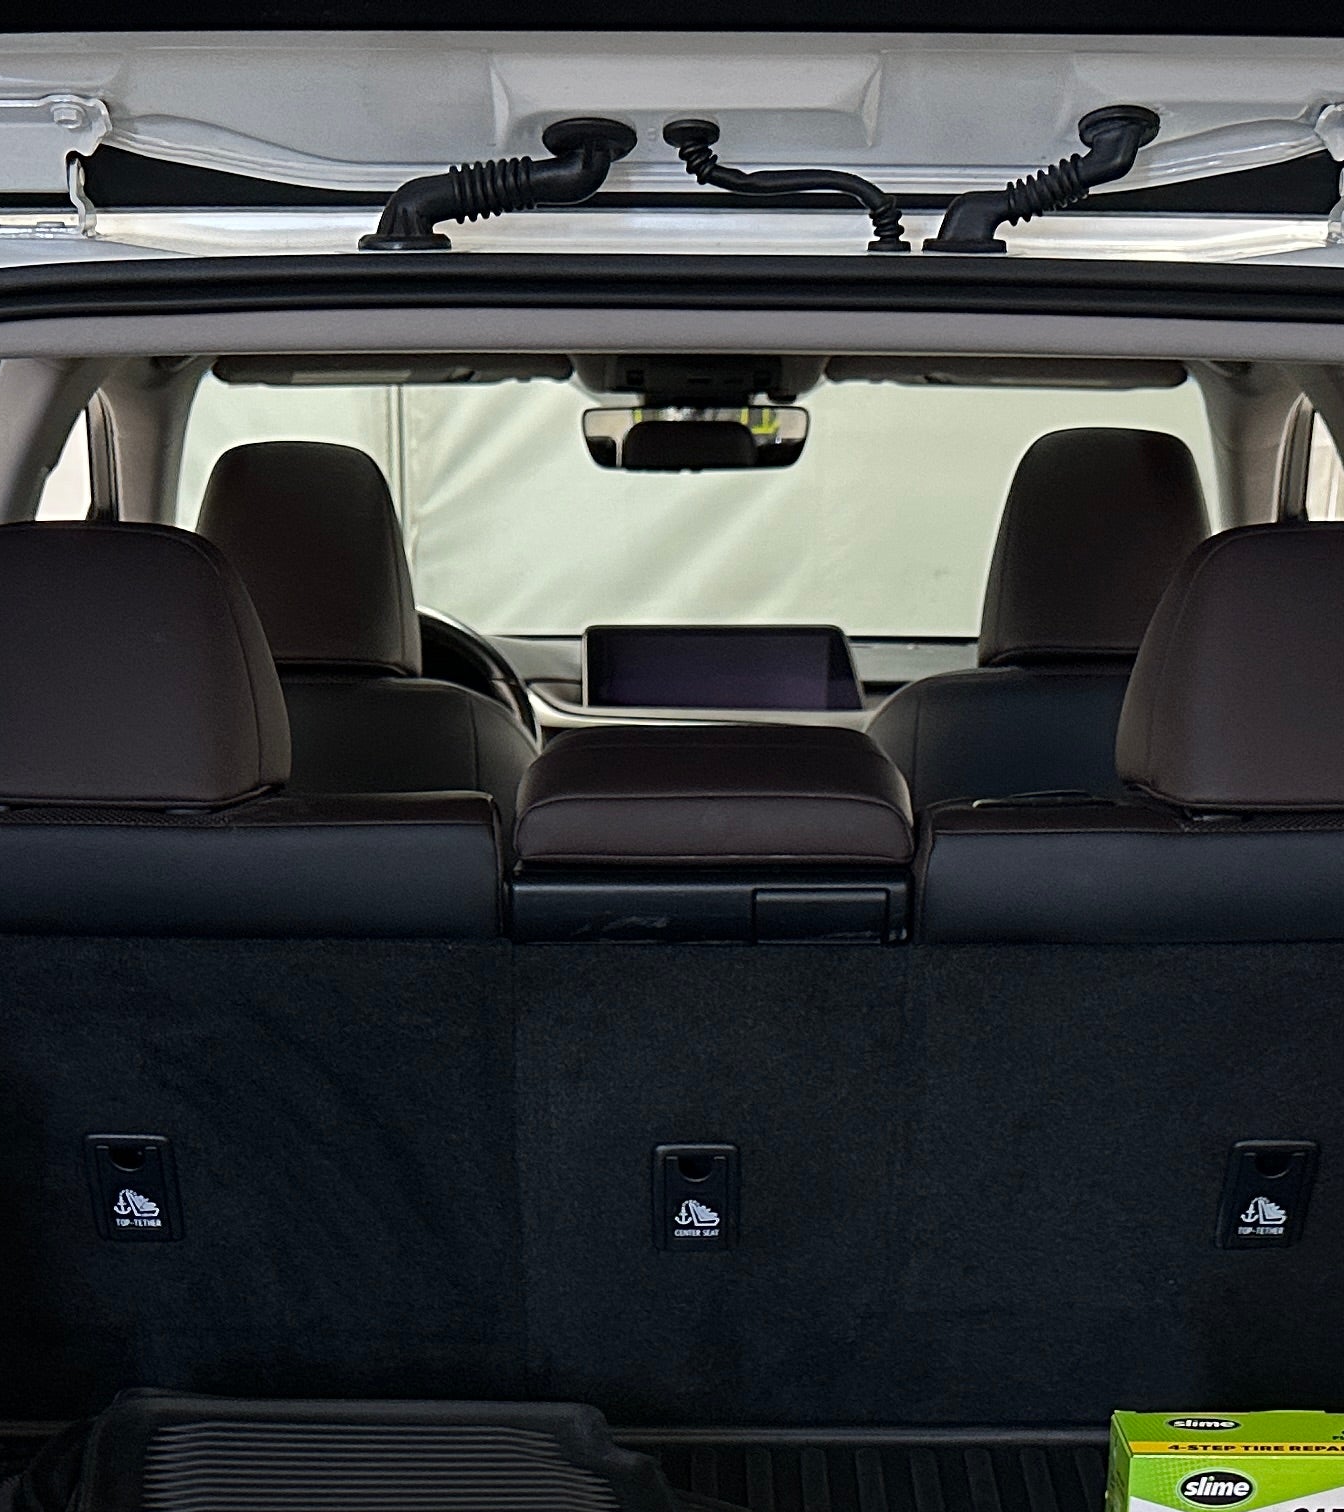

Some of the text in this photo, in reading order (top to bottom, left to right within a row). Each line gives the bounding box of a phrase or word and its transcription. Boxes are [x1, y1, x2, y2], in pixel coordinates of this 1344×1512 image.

[115, 1218, 162, 1227] TOP-TETHER
[674, 1229, 720, 1237] CENTER SEAT
[1173, 1419, 1236, 1428] slime
[1167, 1444, 1237, 1452] 4-STEP
[1240, 1444, 1285, 1452] TIRE
[1183, 1475, 1251, 1497] slime
